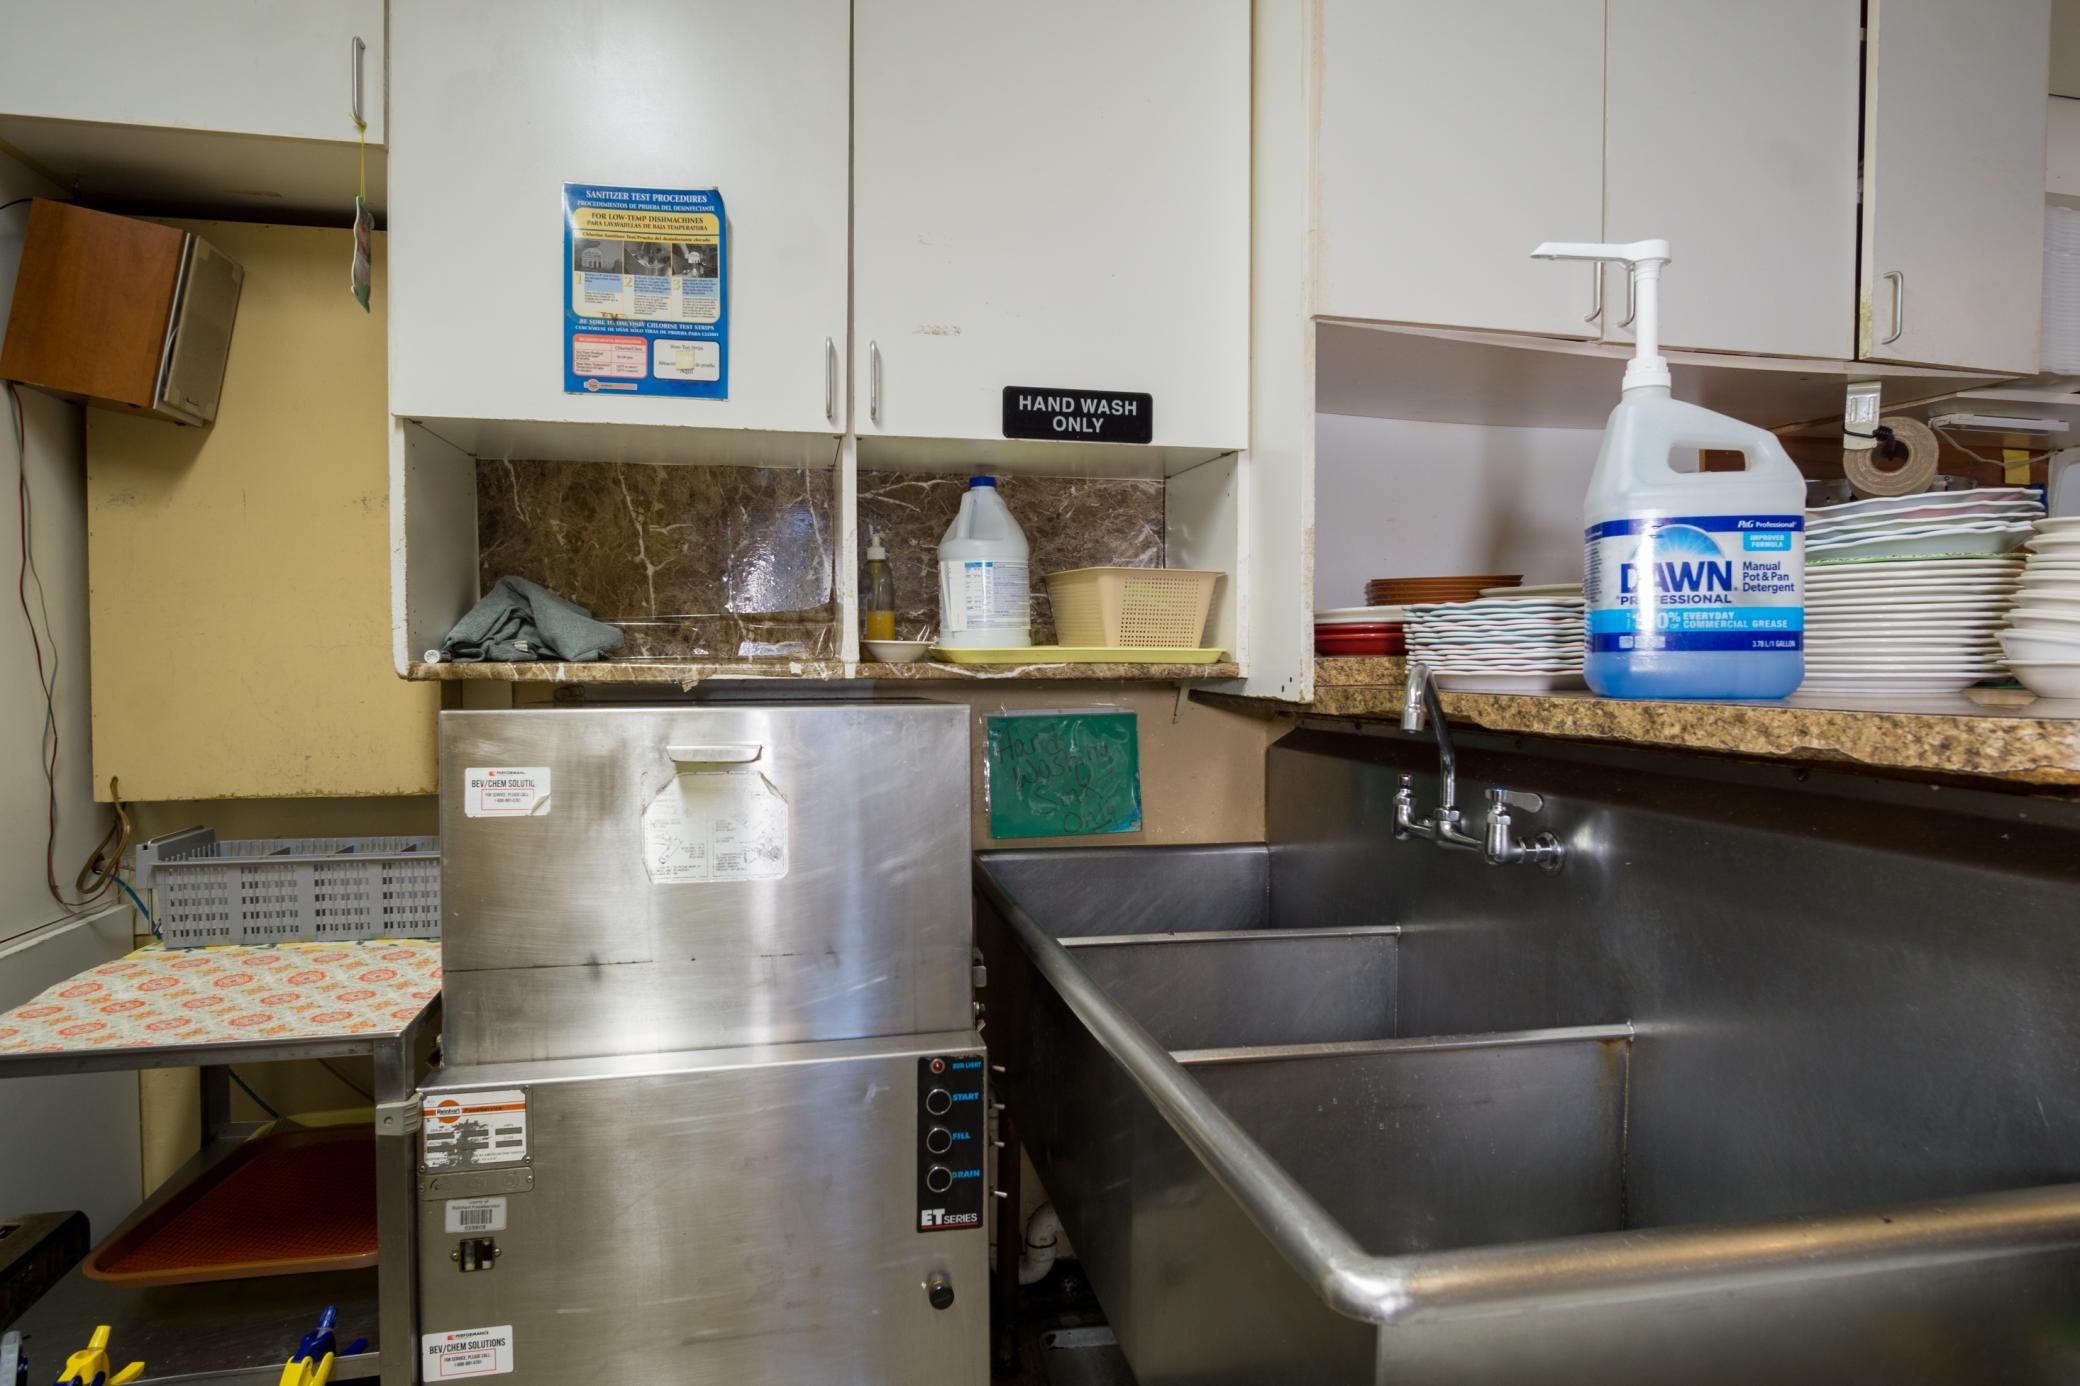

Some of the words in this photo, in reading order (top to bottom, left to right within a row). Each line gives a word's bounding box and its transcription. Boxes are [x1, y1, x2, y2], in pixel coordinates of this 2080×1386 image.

[586, 190, 629, 200] SANITIZER
[631, 193, 650, 201] TEST
[653, 194, 707, 203] PROCEDURES
[608, 214, 647, 222] LOW-TEMP
[649, 216, 704, 224] DISHMACHINES
[625, 277, 633, 287] 2
[674, 279, 681, 290] 3
[1019, 395, 1074, 413] HAND
[1080, 398, 1137, 416] WASH
[1052, 416, 1104, 433] ONLY
[1737, 520, 1754, 529] P&G
[1743, 561, 1781, 571] Manual
[1743, 572, 1761, 581] Pot
[1761, 572, 1770, 581] &
[1771, 572, 1790, 581] Pan
[1743, 583, 1795, 594] Detergent
[1620, 594, 1732, 606] PRESSIONAL
[1683, 611, 1735, 620] EVERYDAY
[1683, 620, 1748, 629] COMMERCIAL
[1752, 619, 1788, 628] GREASE
[471, 779, 507, 788] BEV/CHEM
[952, 1092, 979, 1101] START
[952, 1131, 971, 1140] FILL
[952, 1170, 980, 1178] DRAIN
[921, 1208, 945, 1226] ET
[944, 1213, 978, 1224] SERIES
[429, 1342, 467, 1355] BEV/CHEM
[468, 1338, 506, 1349] SOLUTIONS
